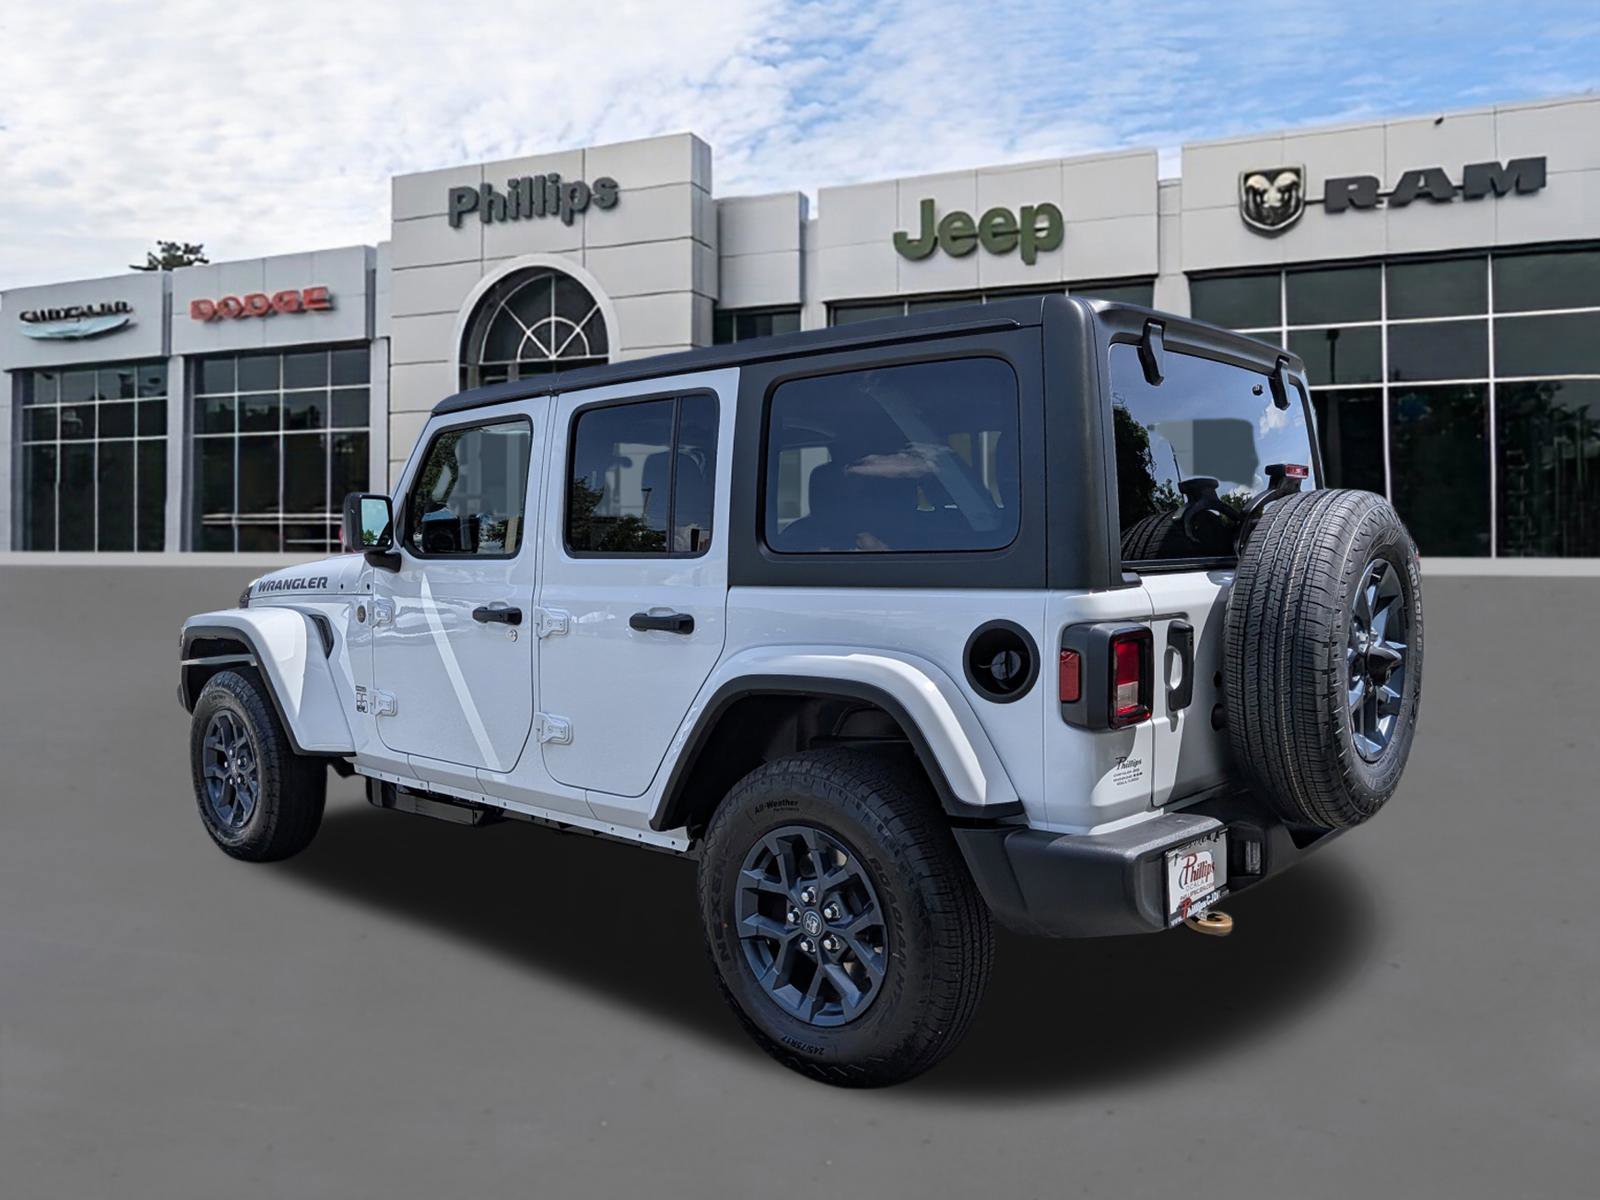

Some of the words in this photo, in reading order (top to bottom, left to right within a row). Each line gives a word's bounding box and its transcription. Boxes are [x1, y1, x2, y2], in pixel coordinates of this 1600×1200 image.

[448, 173, 619, 229] Phillips
[1324, 156, 1547, 215] RAM
[893, 198, 1064, 266] Jeep
[190, 285, 332, 322] DODGE
[257, 576, 328, 593] WRANGLER
[1180, 853, 1215, 887] Phillips
